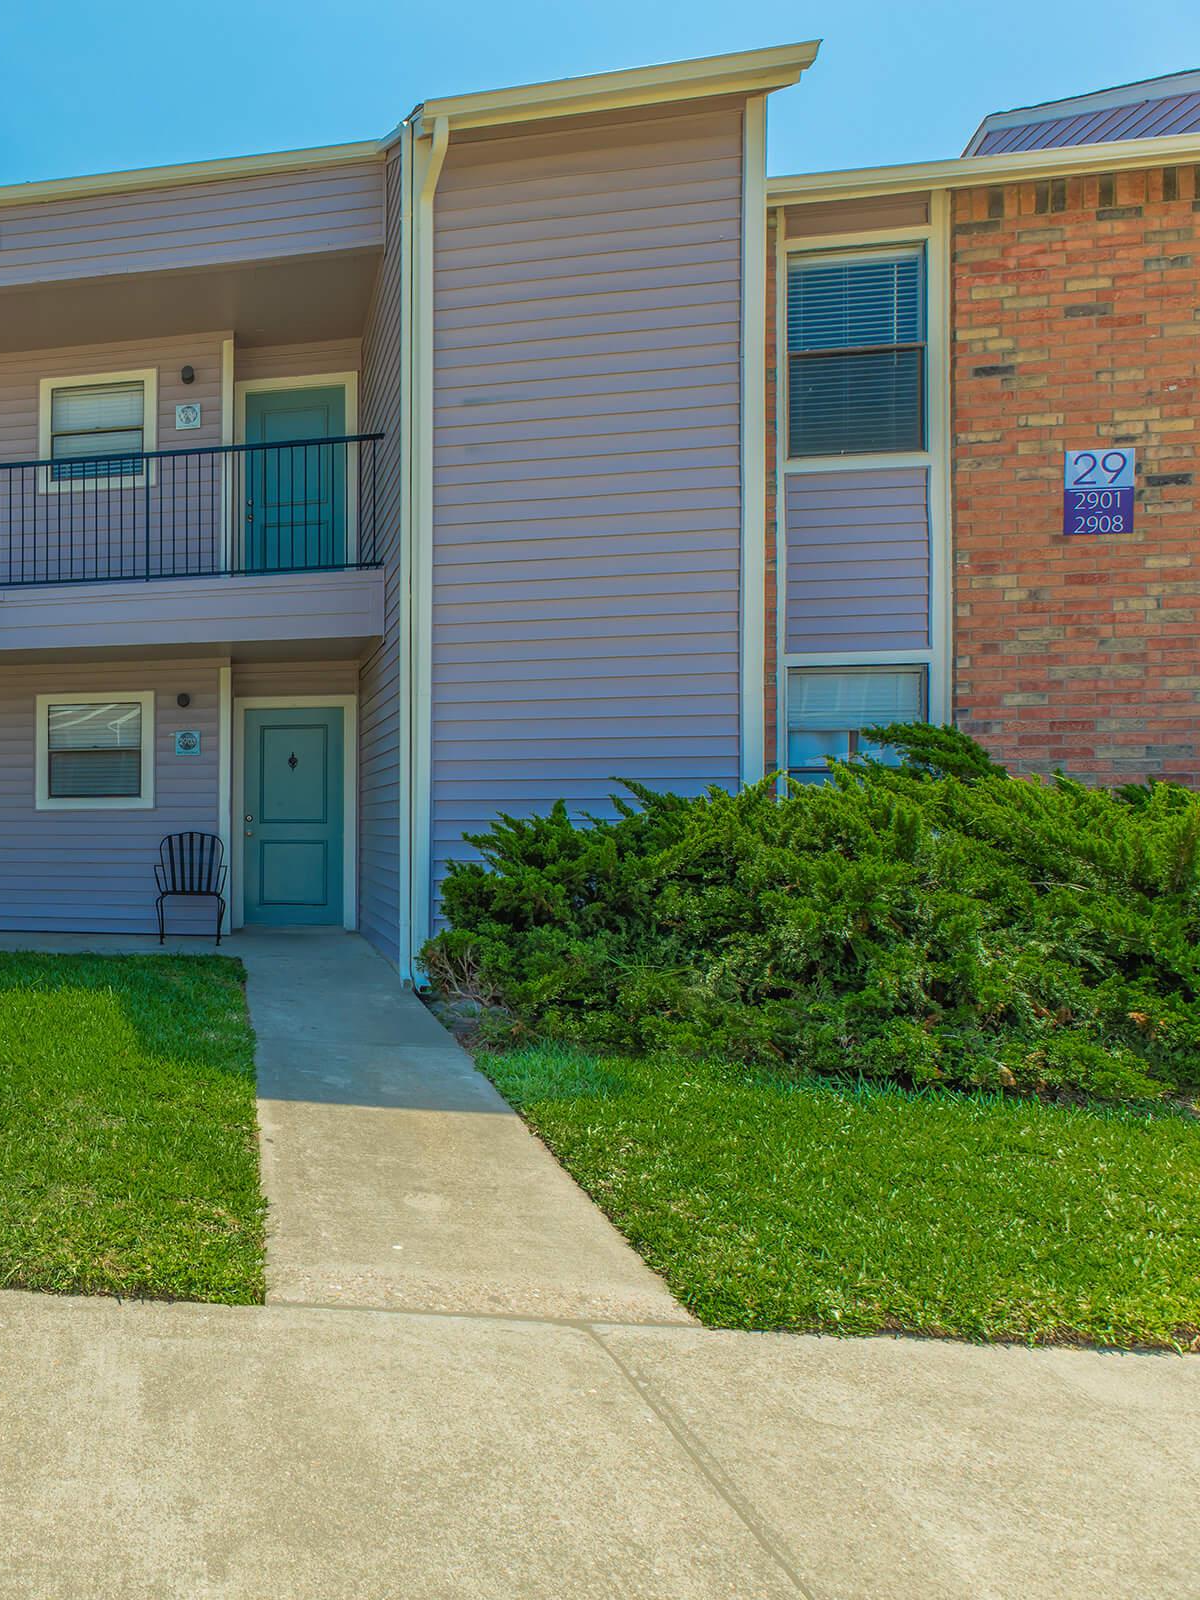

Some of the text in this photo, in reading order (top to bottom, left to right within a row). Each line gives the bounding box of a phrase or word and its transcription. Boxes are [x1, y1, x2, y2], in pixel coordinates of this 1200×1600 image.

[1073, 452, 1127, 485] 29
[1074, 491, 1121, 510] 2901
[1074, 515, 1124, 534] 2908
